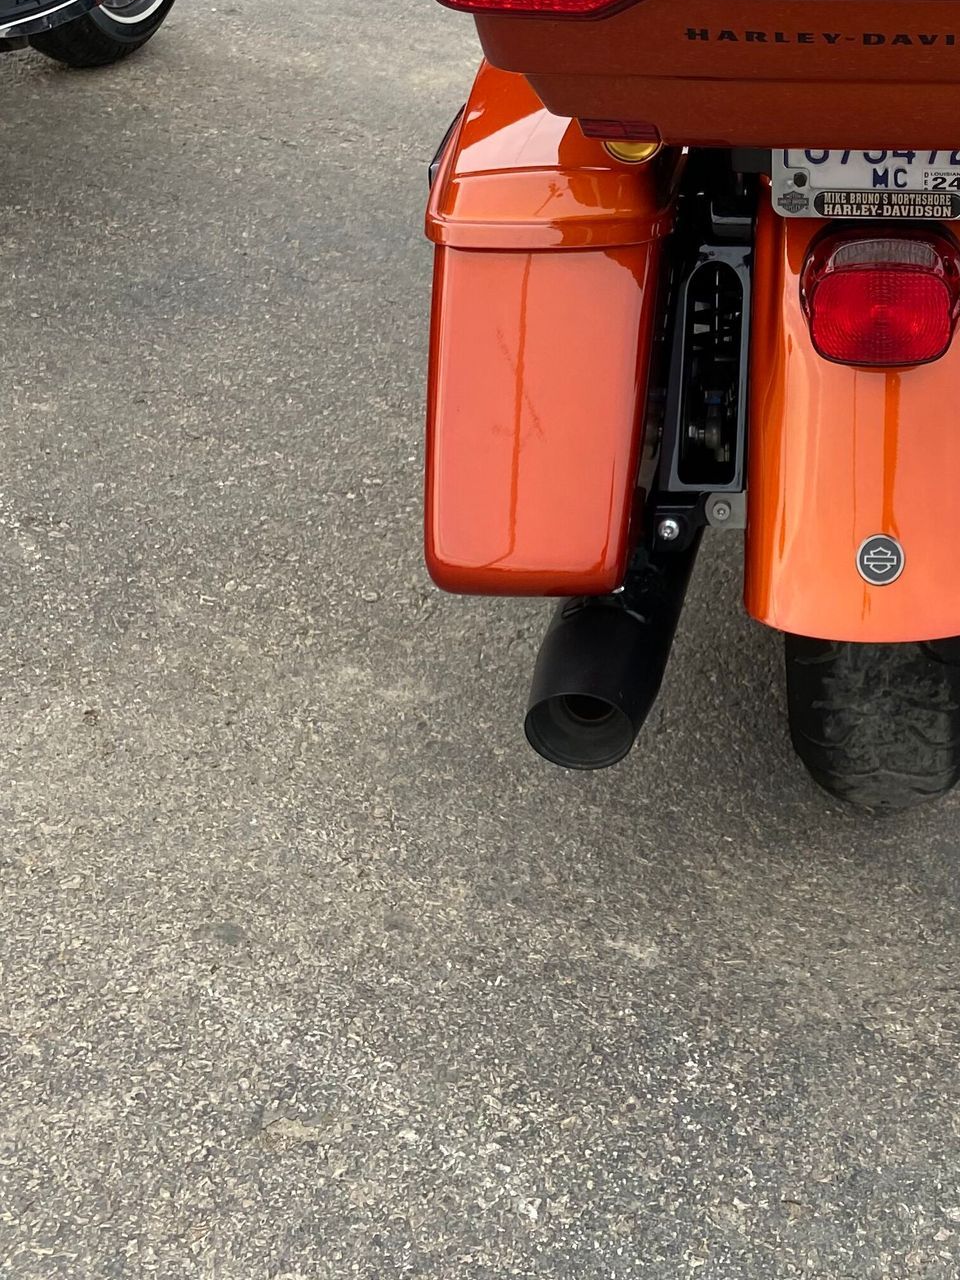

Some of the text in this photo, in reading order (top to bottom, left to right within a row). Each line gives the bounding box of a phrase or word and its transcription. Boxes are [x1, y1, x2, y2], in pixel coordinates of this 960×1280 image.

[872, 167, 908, 188] MC
[823, 192, 847, 204] MIKE
[849, 192, 889, 205] BRUNO'S
[891, 193, 951, 206] NORTHSHORE
[823, 204, 952, 217] HARLEY-DAVIDSON
